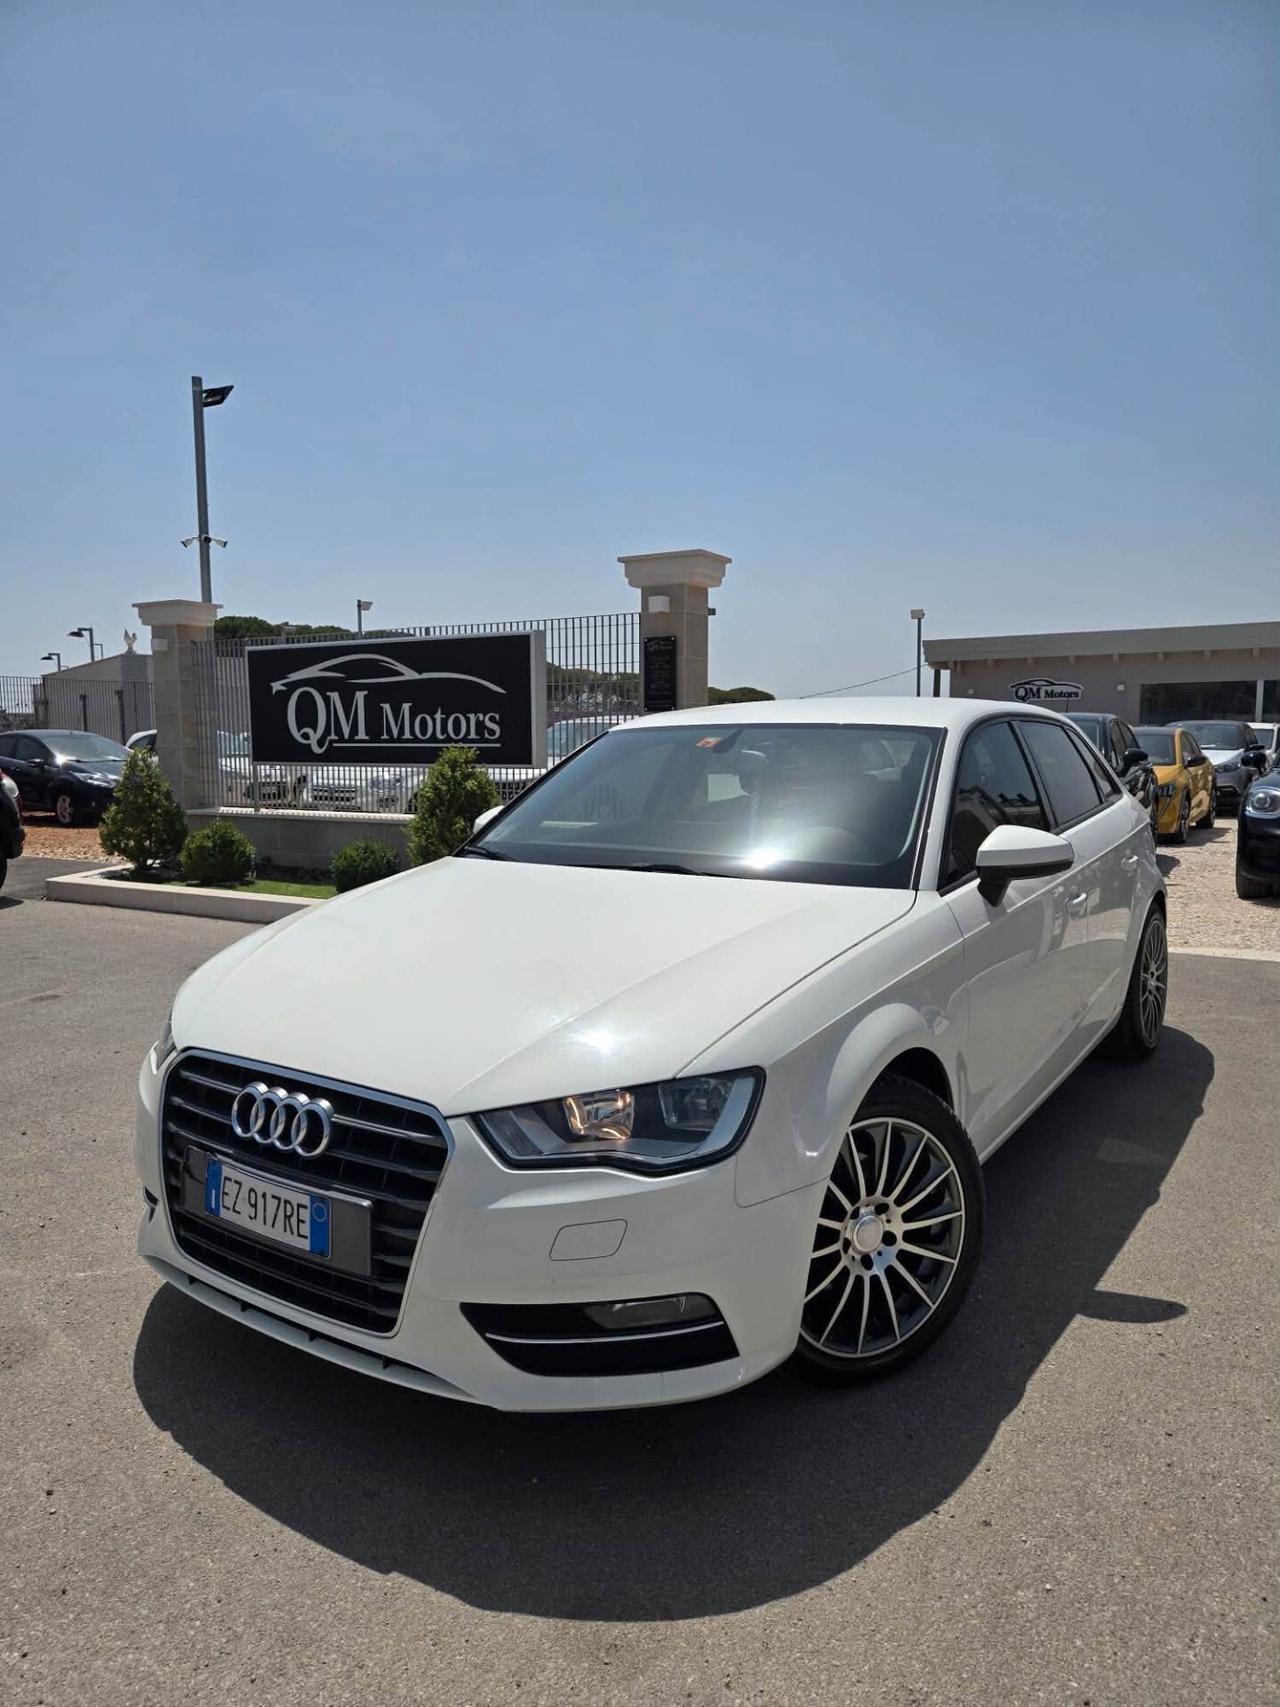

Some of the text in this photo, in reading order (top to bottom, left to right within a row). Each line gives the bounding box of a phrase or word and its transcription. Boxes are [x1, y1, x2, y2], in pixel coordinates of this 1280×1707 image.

[287, 687, 501, 754] QM Motors
[1015, 686, 1079, 703] QM Motors
[221, 1176, 308, 1240] EZ 917RE
